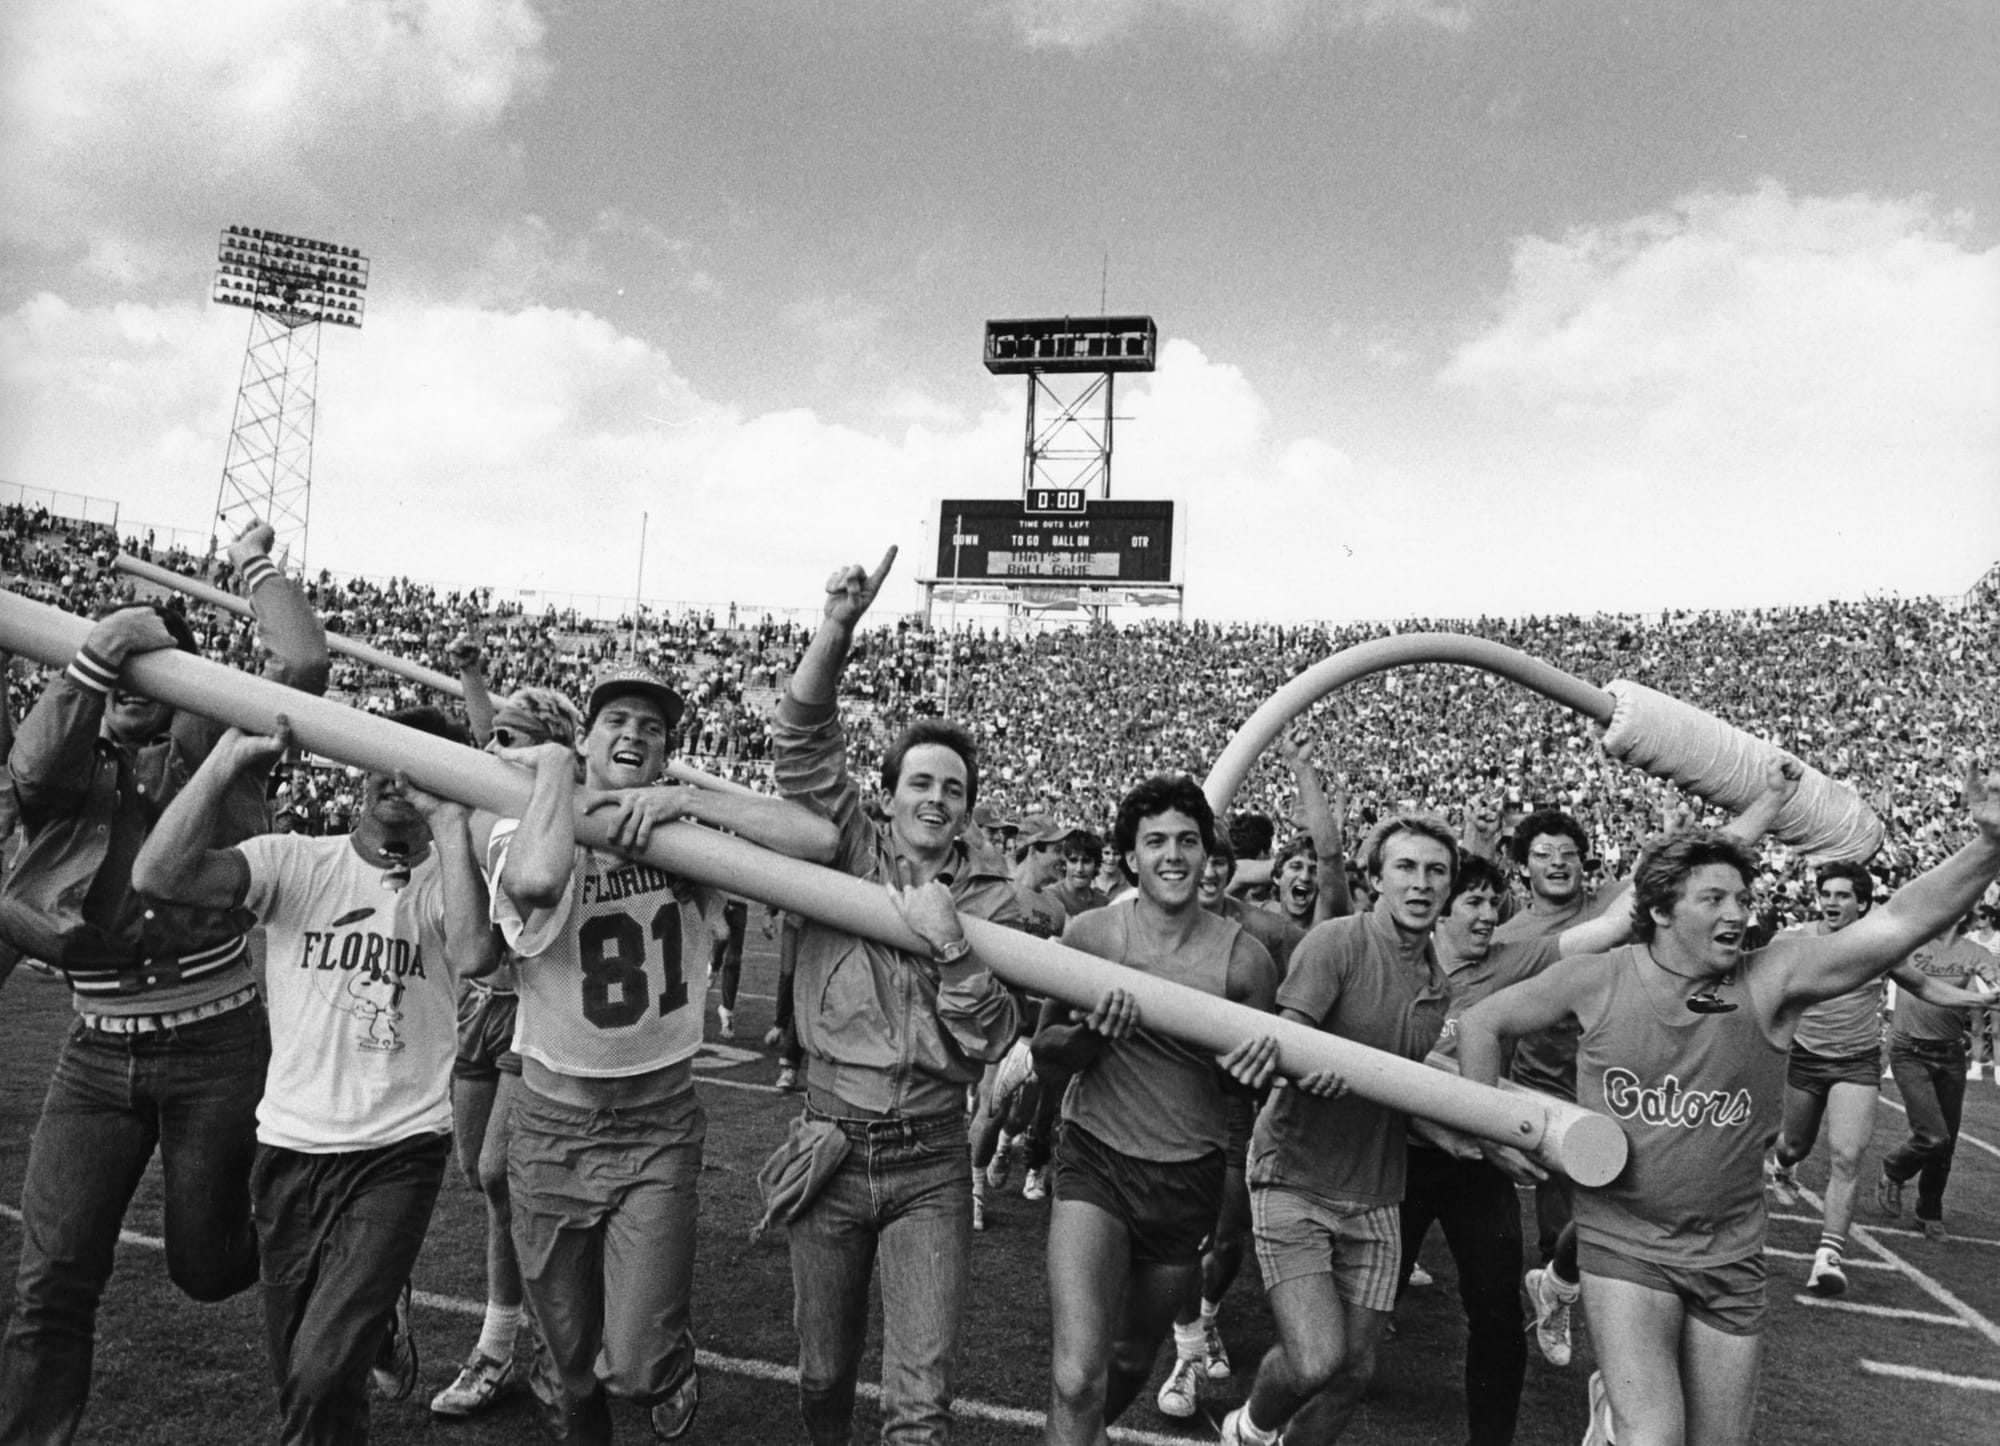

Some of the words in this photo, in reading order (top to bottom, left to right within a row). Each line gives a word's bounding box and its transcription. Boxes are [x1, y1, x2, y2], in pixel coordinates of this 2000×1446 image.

[1038, 491, 1080, 509] 0:00
[1019, 520, 1039, 529] TIME
[1042, 520, 1064, 529] OUTS
[1068, 520, 1090, 529] LEFT
[952, 534, 979, 546] DOWN
[1011, 534, 1024, 547] TO
[1026, 534, 1040, 547] GO
[1052, 534, 1075, 547] BALL
[1077, 535, 1090, 547] ON
[1010, 551, 1061, 563] THAT'S
[1069, 552, 1096, 563] THE
[1007, 563, 1043, 575] BALL
[1052, 564, 1092, 575] GAME
[582, 866, 667, 904] FLORID
[301, 930, 426, 980] FLORIDA
[578, 902, 689, 1030] 81
[1603, 1066, 1752, 1128] Gators
